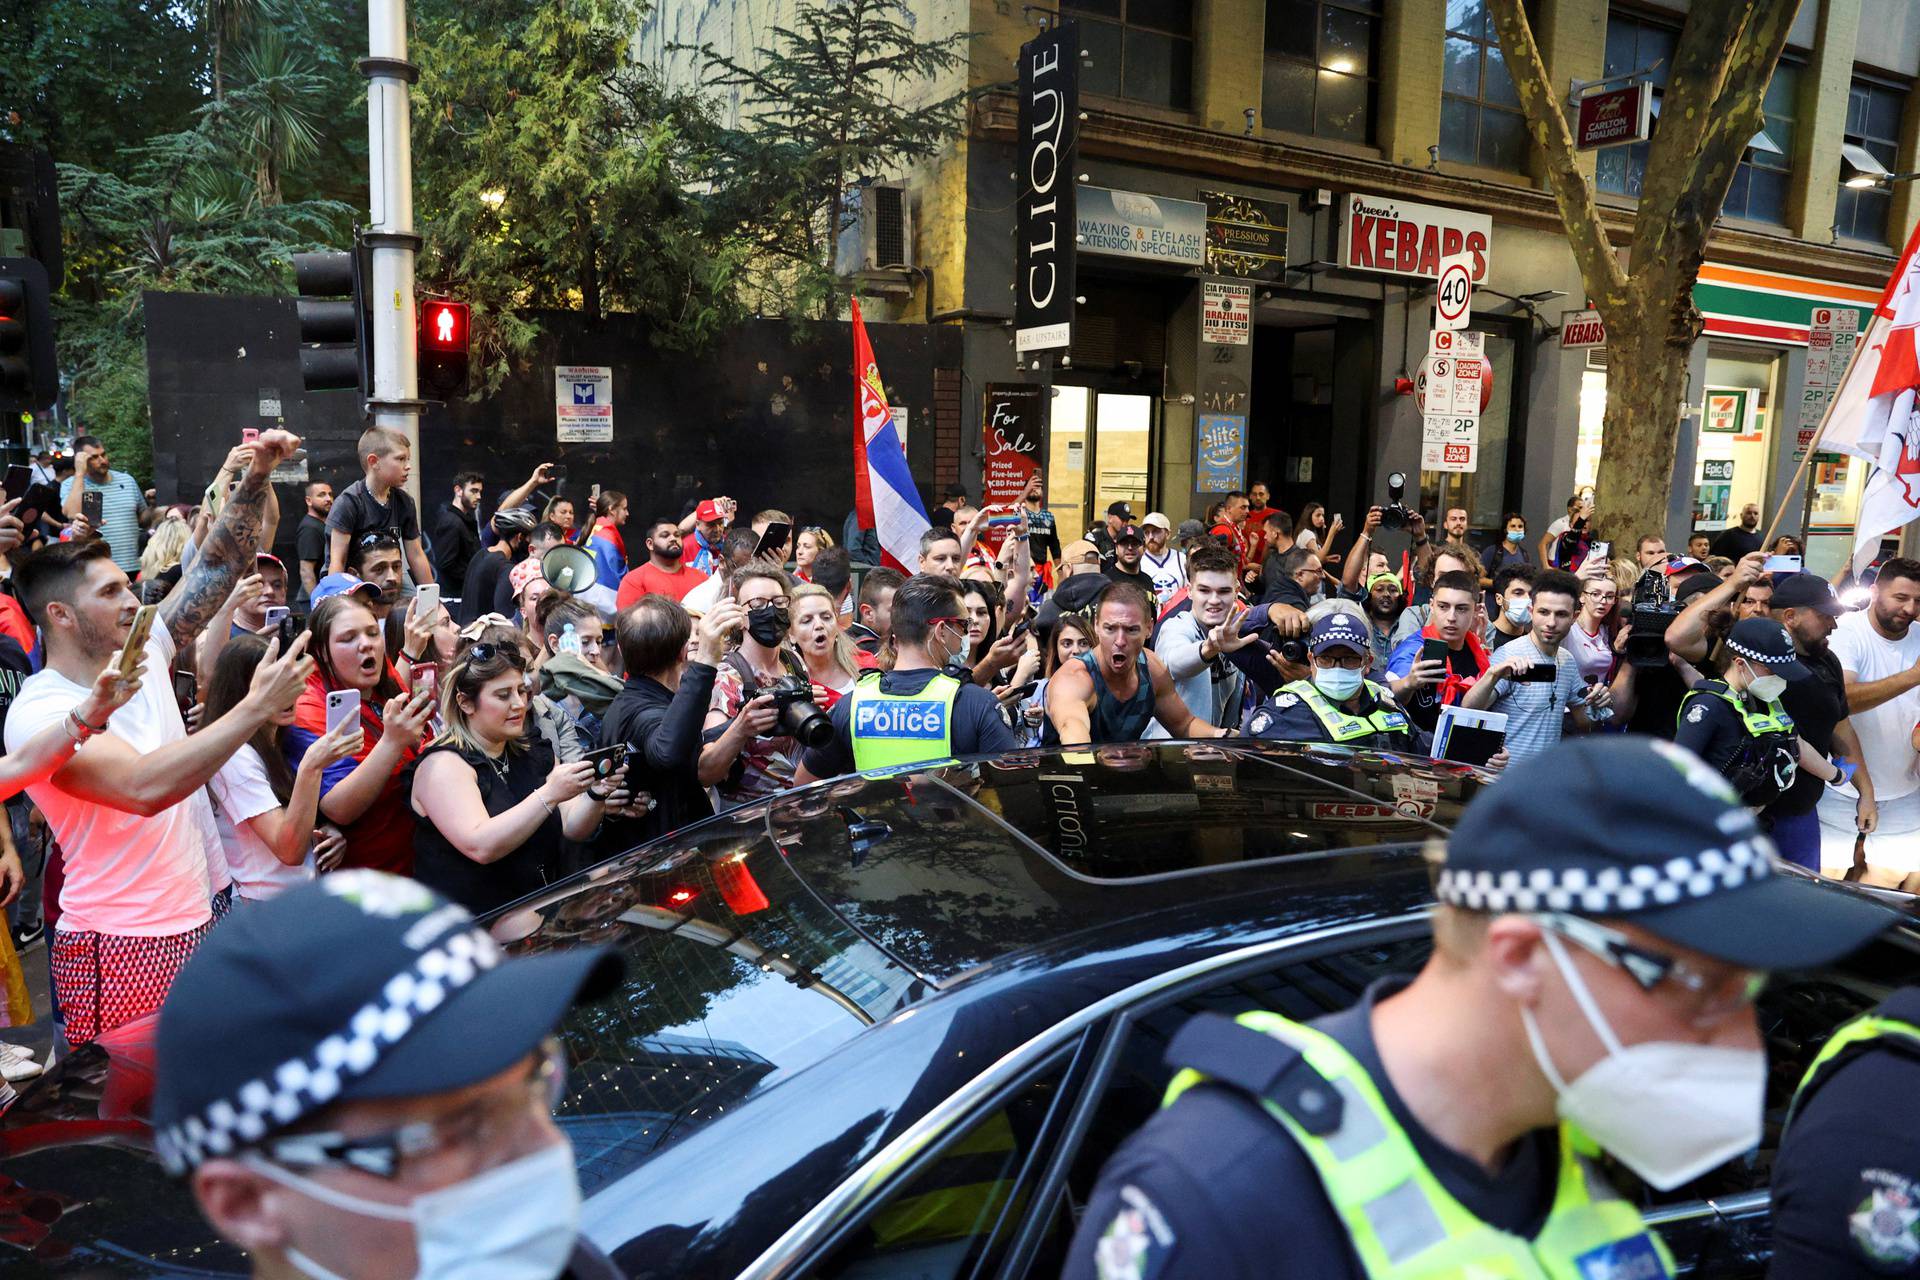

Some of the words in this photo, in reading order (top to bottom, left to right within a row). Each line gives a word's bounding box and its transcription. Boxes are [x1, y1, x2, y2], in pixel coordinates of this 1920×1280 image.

[1588, 117, 1627, 131] CARLTON
[1585, 125, 1628, 141] DRAUGHT
[1029, 43, 1065, 310] CLIQUE
[1352, 201, 1399, 219] Queen's
[1078, 220, 1130, 238] WAXING
[1136, 227, 1144, 240] &
[1152, 229, 1200, 247] EYELASH
[1078, 233, 1138, 252] EXTENSION
[1141, 242, 1200, 260] SPECIALISTS
[1350, 213, 1487, 281] KEBABS
[1205, 284, 1217, 293] CIA
[1218, 285, 1250, 295] PAULISTA
[1441, 277, 1467, 306] 40
[1205, 310, 1248, 322] BRAZILIAN
[1205, 319, 1219, 328] JIU
[1221, 320, 1248, 330] JITSU
[1438, 333, 1450, 348] C
[1563, 322, 1605, 345] KEBABS
[1835, 333, 1854, 345] 2P
[1804, 390, 1824, 401] 2P
[1827, 391, 1836, 402] 2
[991, 402, 1020, 428] For
[1454, 418, 1474, 432] 2P
[989, 428, 1036, 456] Sale
[991, 461, 1013, 469] Prized
[1705, 462, 1723, 475] Epic
[991, 470, 1023, 478] Five-level
[857, 706, 941, 732] Police
